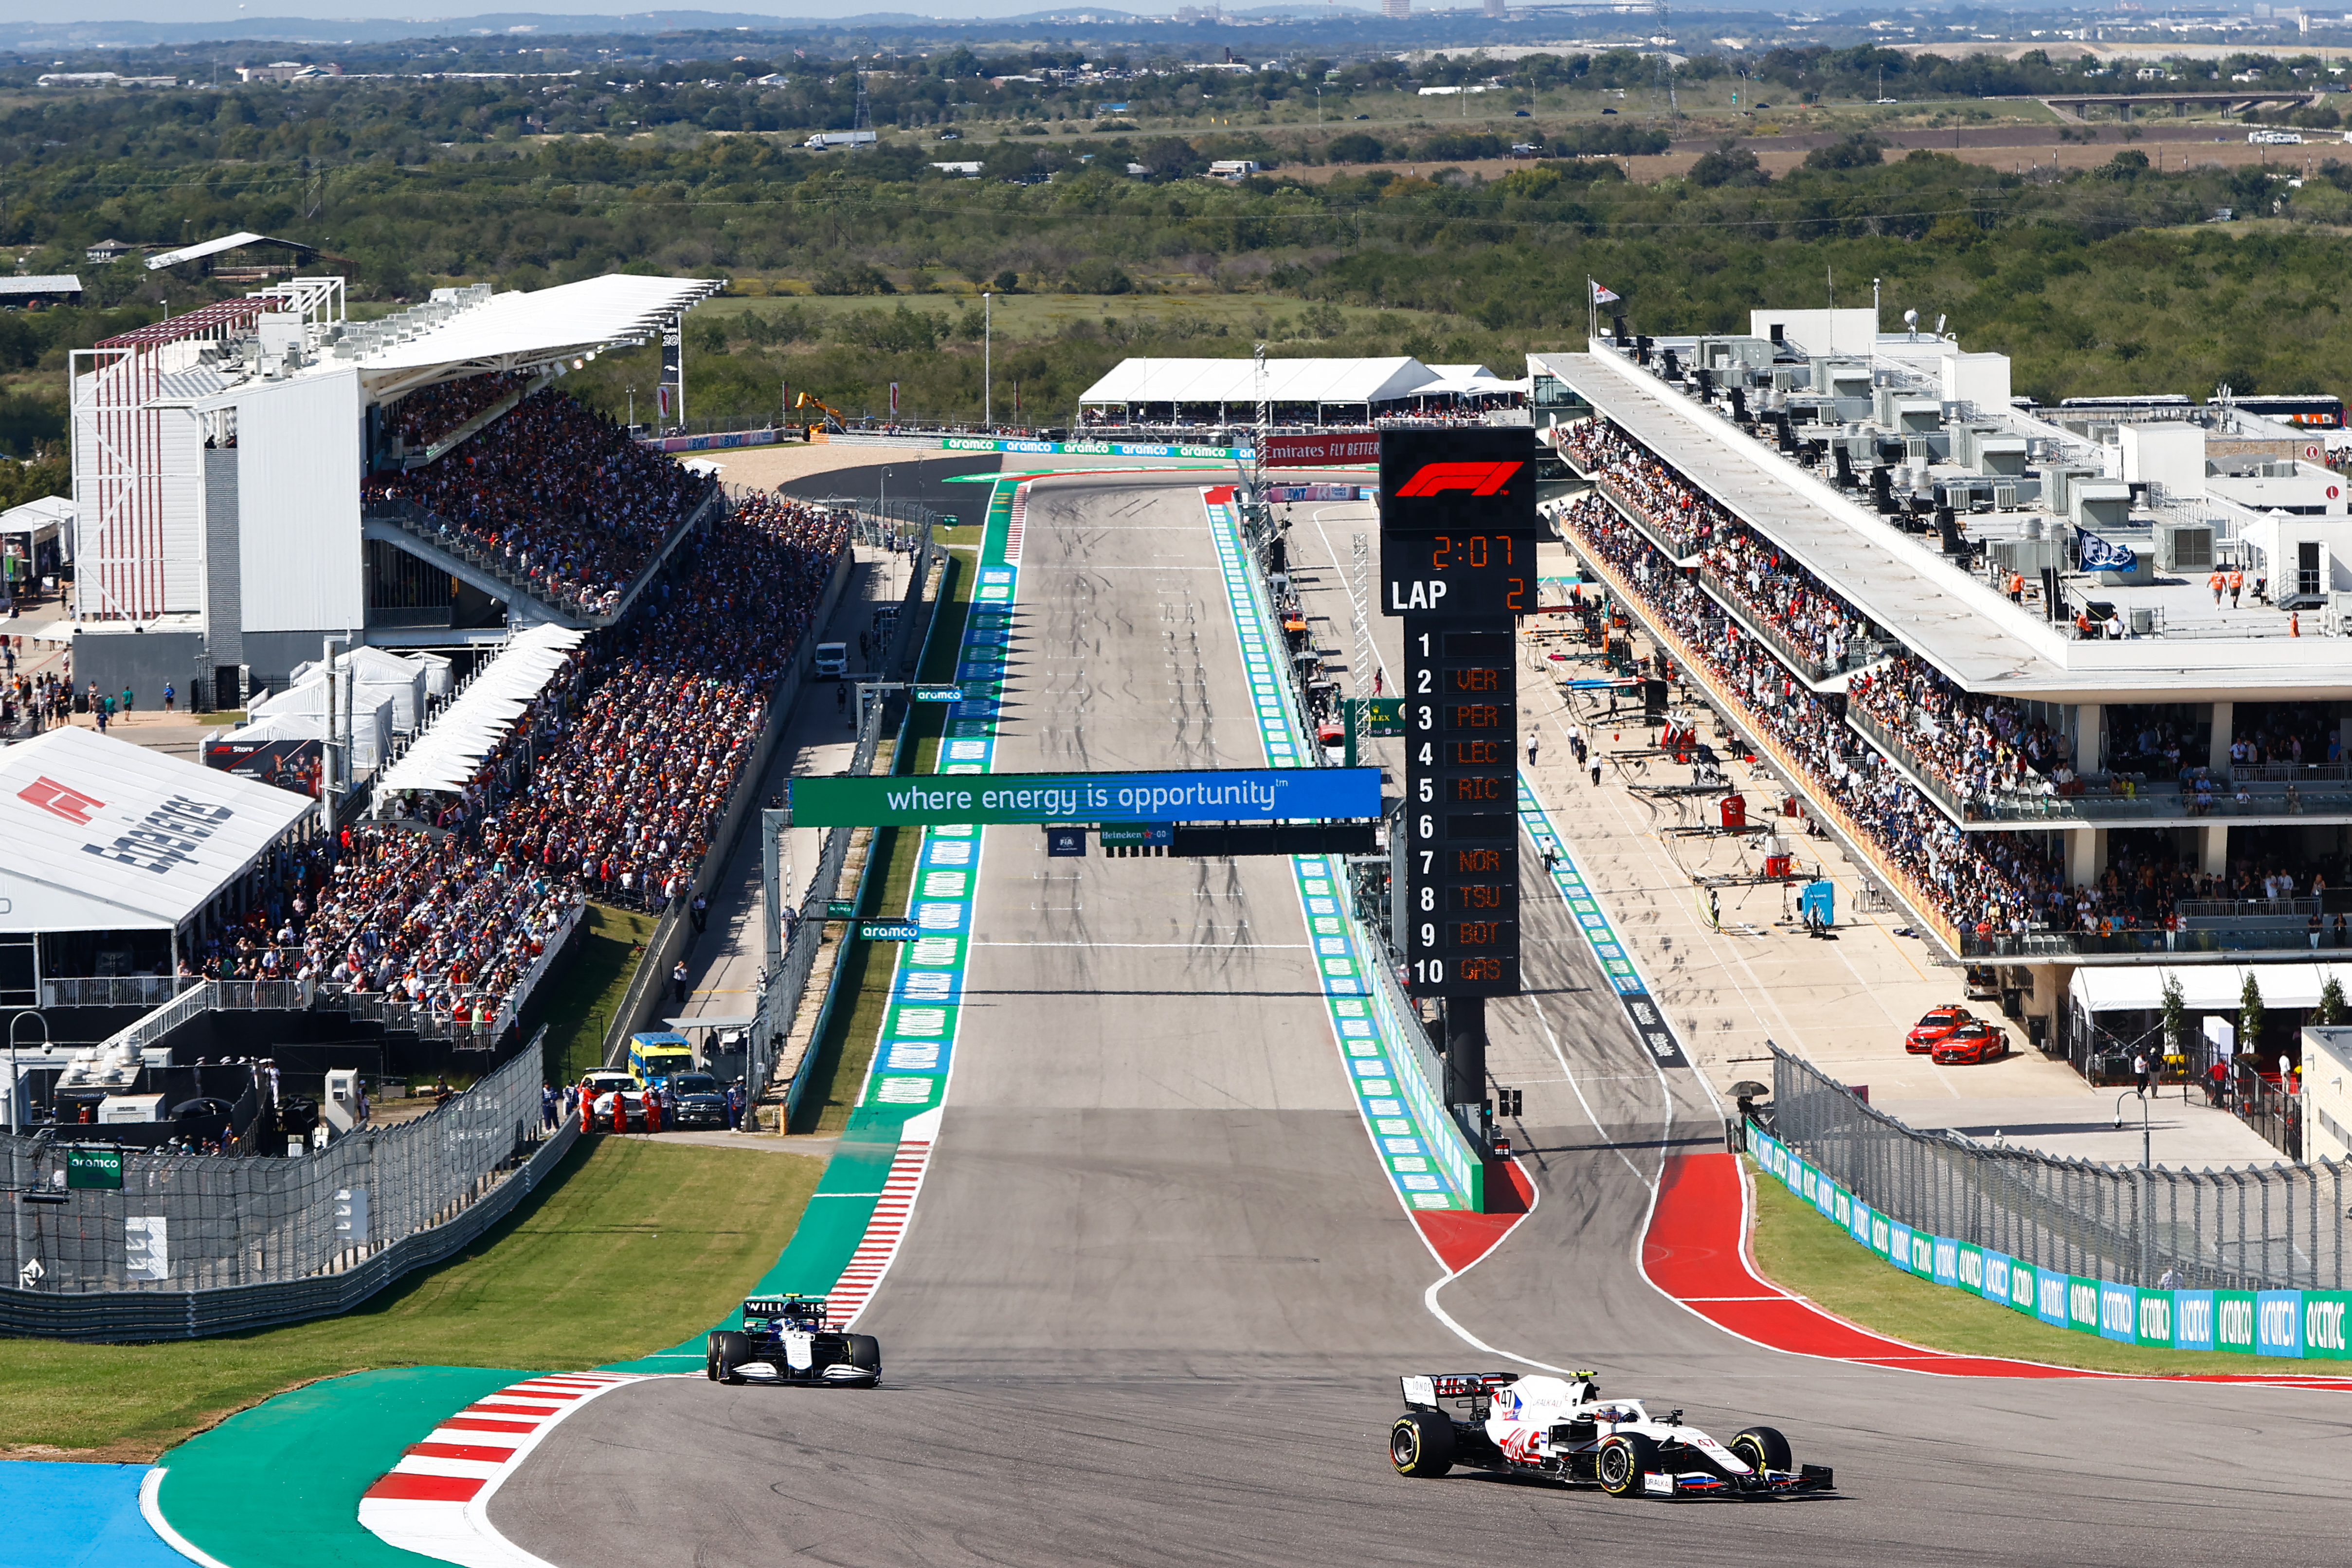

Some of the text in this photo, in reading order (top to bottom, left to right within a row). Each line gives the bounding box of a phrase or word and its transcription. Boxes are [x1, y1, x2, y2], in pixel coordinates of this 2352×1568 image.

[662, 335, 678, 346] 20
[949, 439, 1226, 457] aramco aramco aramco aramco aramco
[1264, 445, 1324, 458] Emirates
[1330, 443, 1345, 456] FLY
[1347, 442, 1379, 456] BETTER
[2309, 447, 2315, 457] K
[2330, 487, 2335, 498] L
[1433, 536, 1512, 567] 2:07
[1392, 578, 1524, 609] LAP 2
[1418, 633, 1429, 657] 1
[1418, 669, 1498, 693] 2 VER
[918, 691, 961, 700] aramco
[1418, 706, 1498, 730] 3 PER
[1419, 742, 1498, 766] 4 LEC
[887, 785, 972, 810] where
[982, 788, 1076, 815] energy
[1087, 784, 1107, 807] is
[1119, 780, 1275, 813] opportunity
[1419, 778, 1498, 802] 5 RIC
[1420, 815, 1433, 839] 6
[1420, 850, 1500, 874] 7 NOR
[1421, 886, 1500, 911] 8 TSU
[863, 926, 917, 937] aramco
[1421, 922, 1499, 947] 9 BOT
[1414, 959, 1501, 983] 10 GAS
[72, 1158, 118, 1168] aramco
[1413, 1381, 1430, 1392] IONOS
[1501, 1390, 1512, 1408] 47
[1697, 1439, 1716, 1447] 47
[1645, 1478, 1673, 1489] URALKALI
